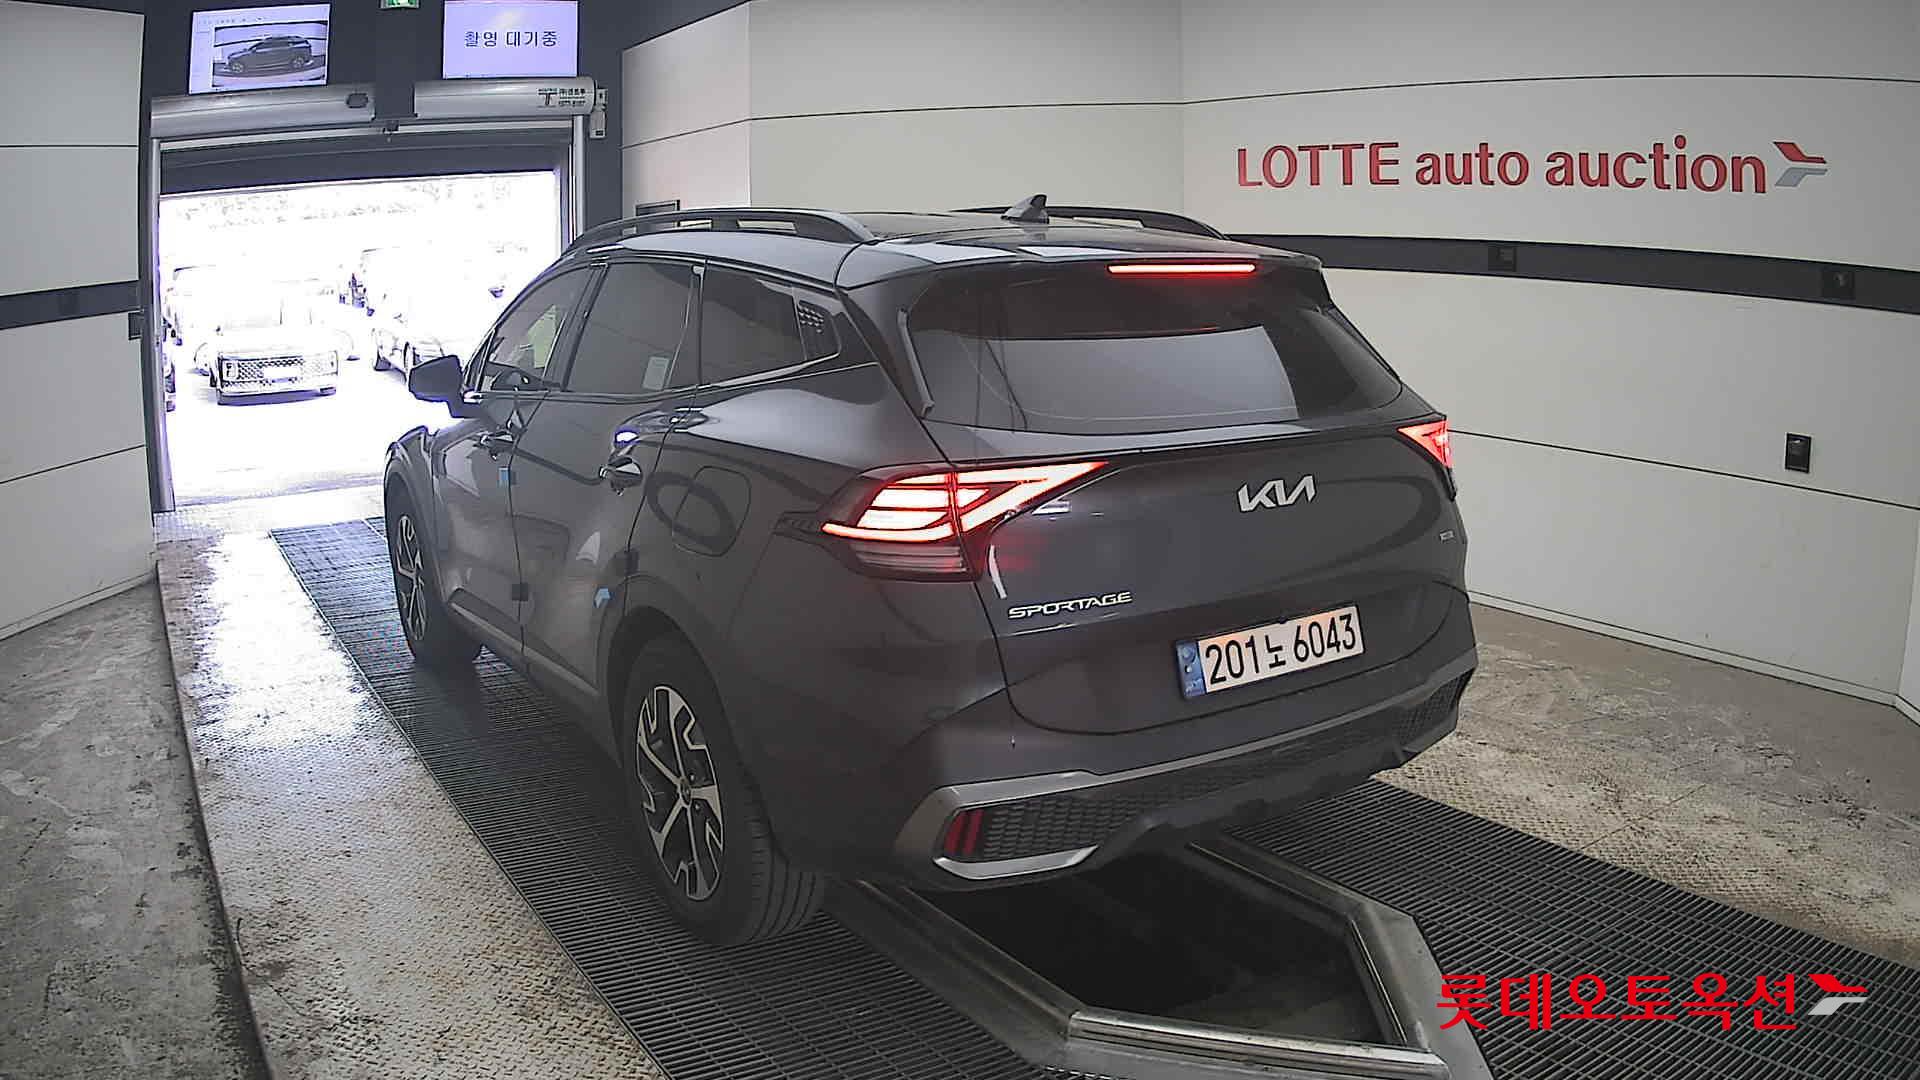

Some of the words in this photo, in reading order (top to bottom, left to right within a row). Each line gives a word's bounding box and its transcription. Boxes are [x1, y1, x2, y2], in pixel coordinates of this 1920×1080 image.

[464, 31, 498, 47] 촬영
[505, 31, 558, 47] 대기중
[1237, 142, 1400, 188] LOTTE
[1415, 142, 1530, 186] auto
[1545, 134, 1767, 193] auction
[1008, 591, 1132, 618] SPORTAGE
